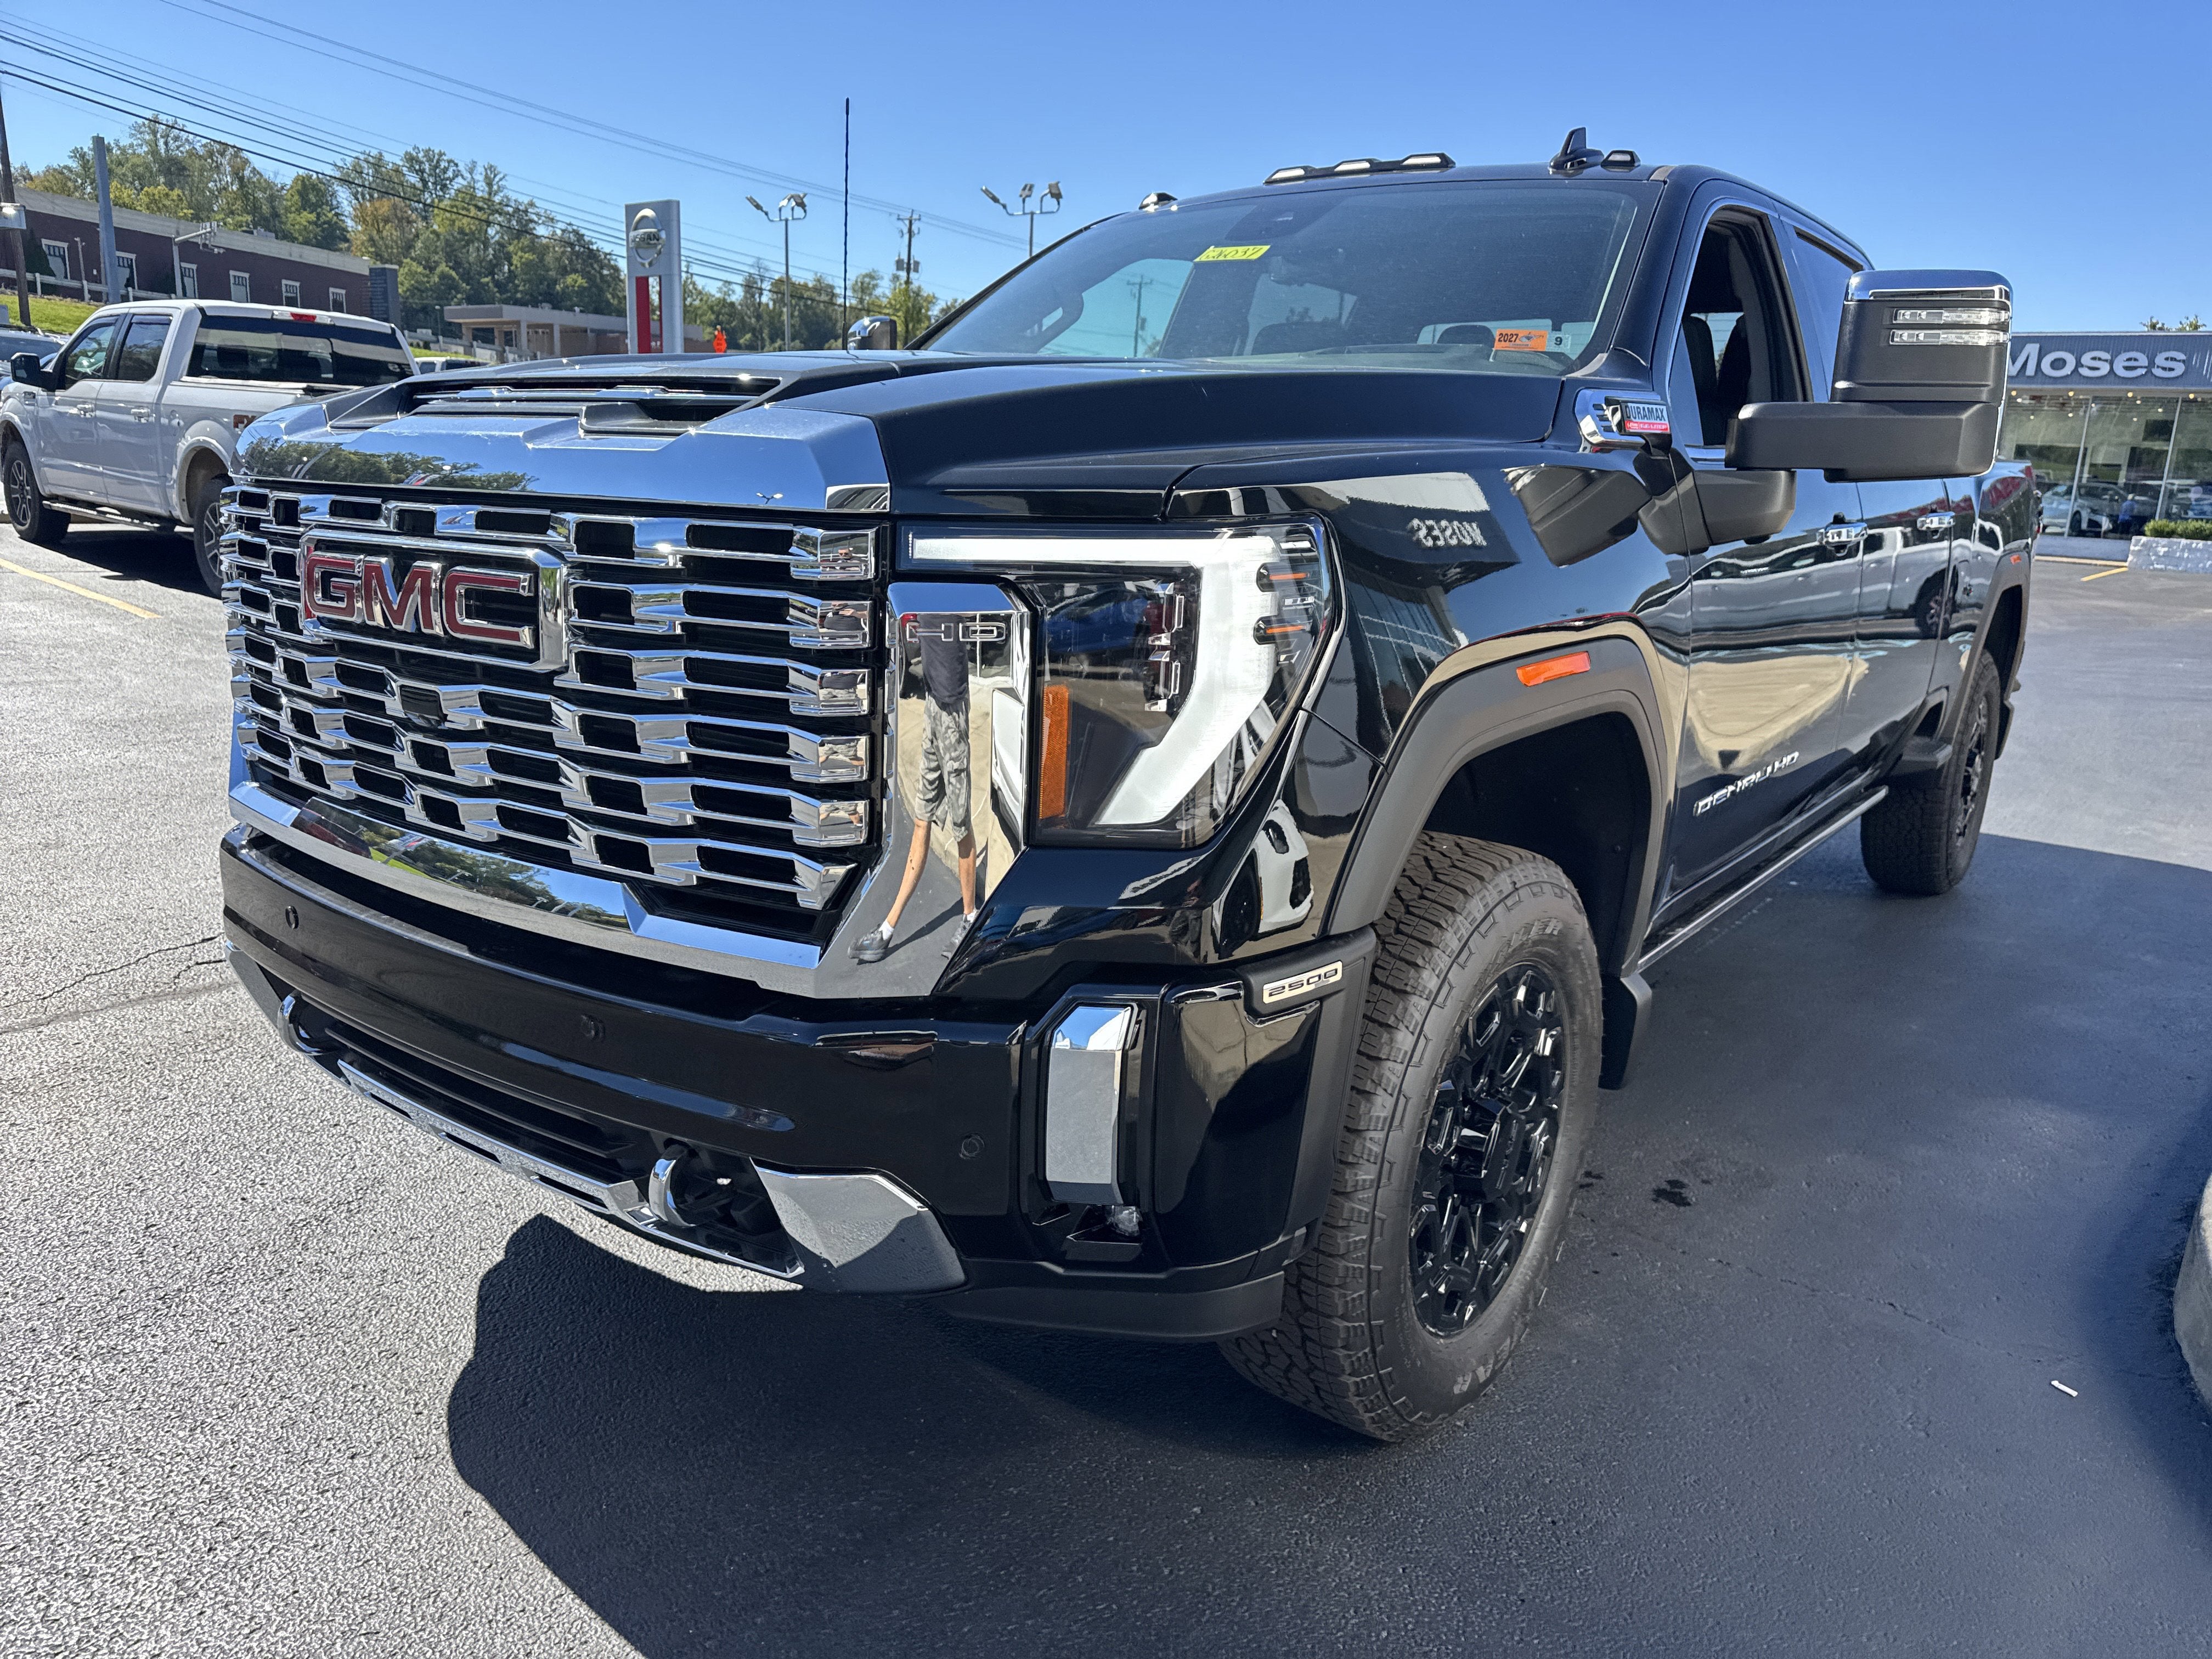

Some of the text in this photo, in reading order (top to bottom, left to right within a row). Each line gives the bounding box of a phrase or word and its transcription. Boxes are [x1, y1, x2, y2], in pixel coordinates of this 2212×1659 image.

[1498, 332, 1519, 343] 2027
[1554, 336, 1563, 346] 9
[2007, 343, 2187, 378] Moses
[1624, 405, 1666, 421] DURAMAX
[305, 551, 535, 649] GMC
[1694, 751, 1799, 816] DENALI HD
[1268, 968, 1338, 997] 2500
